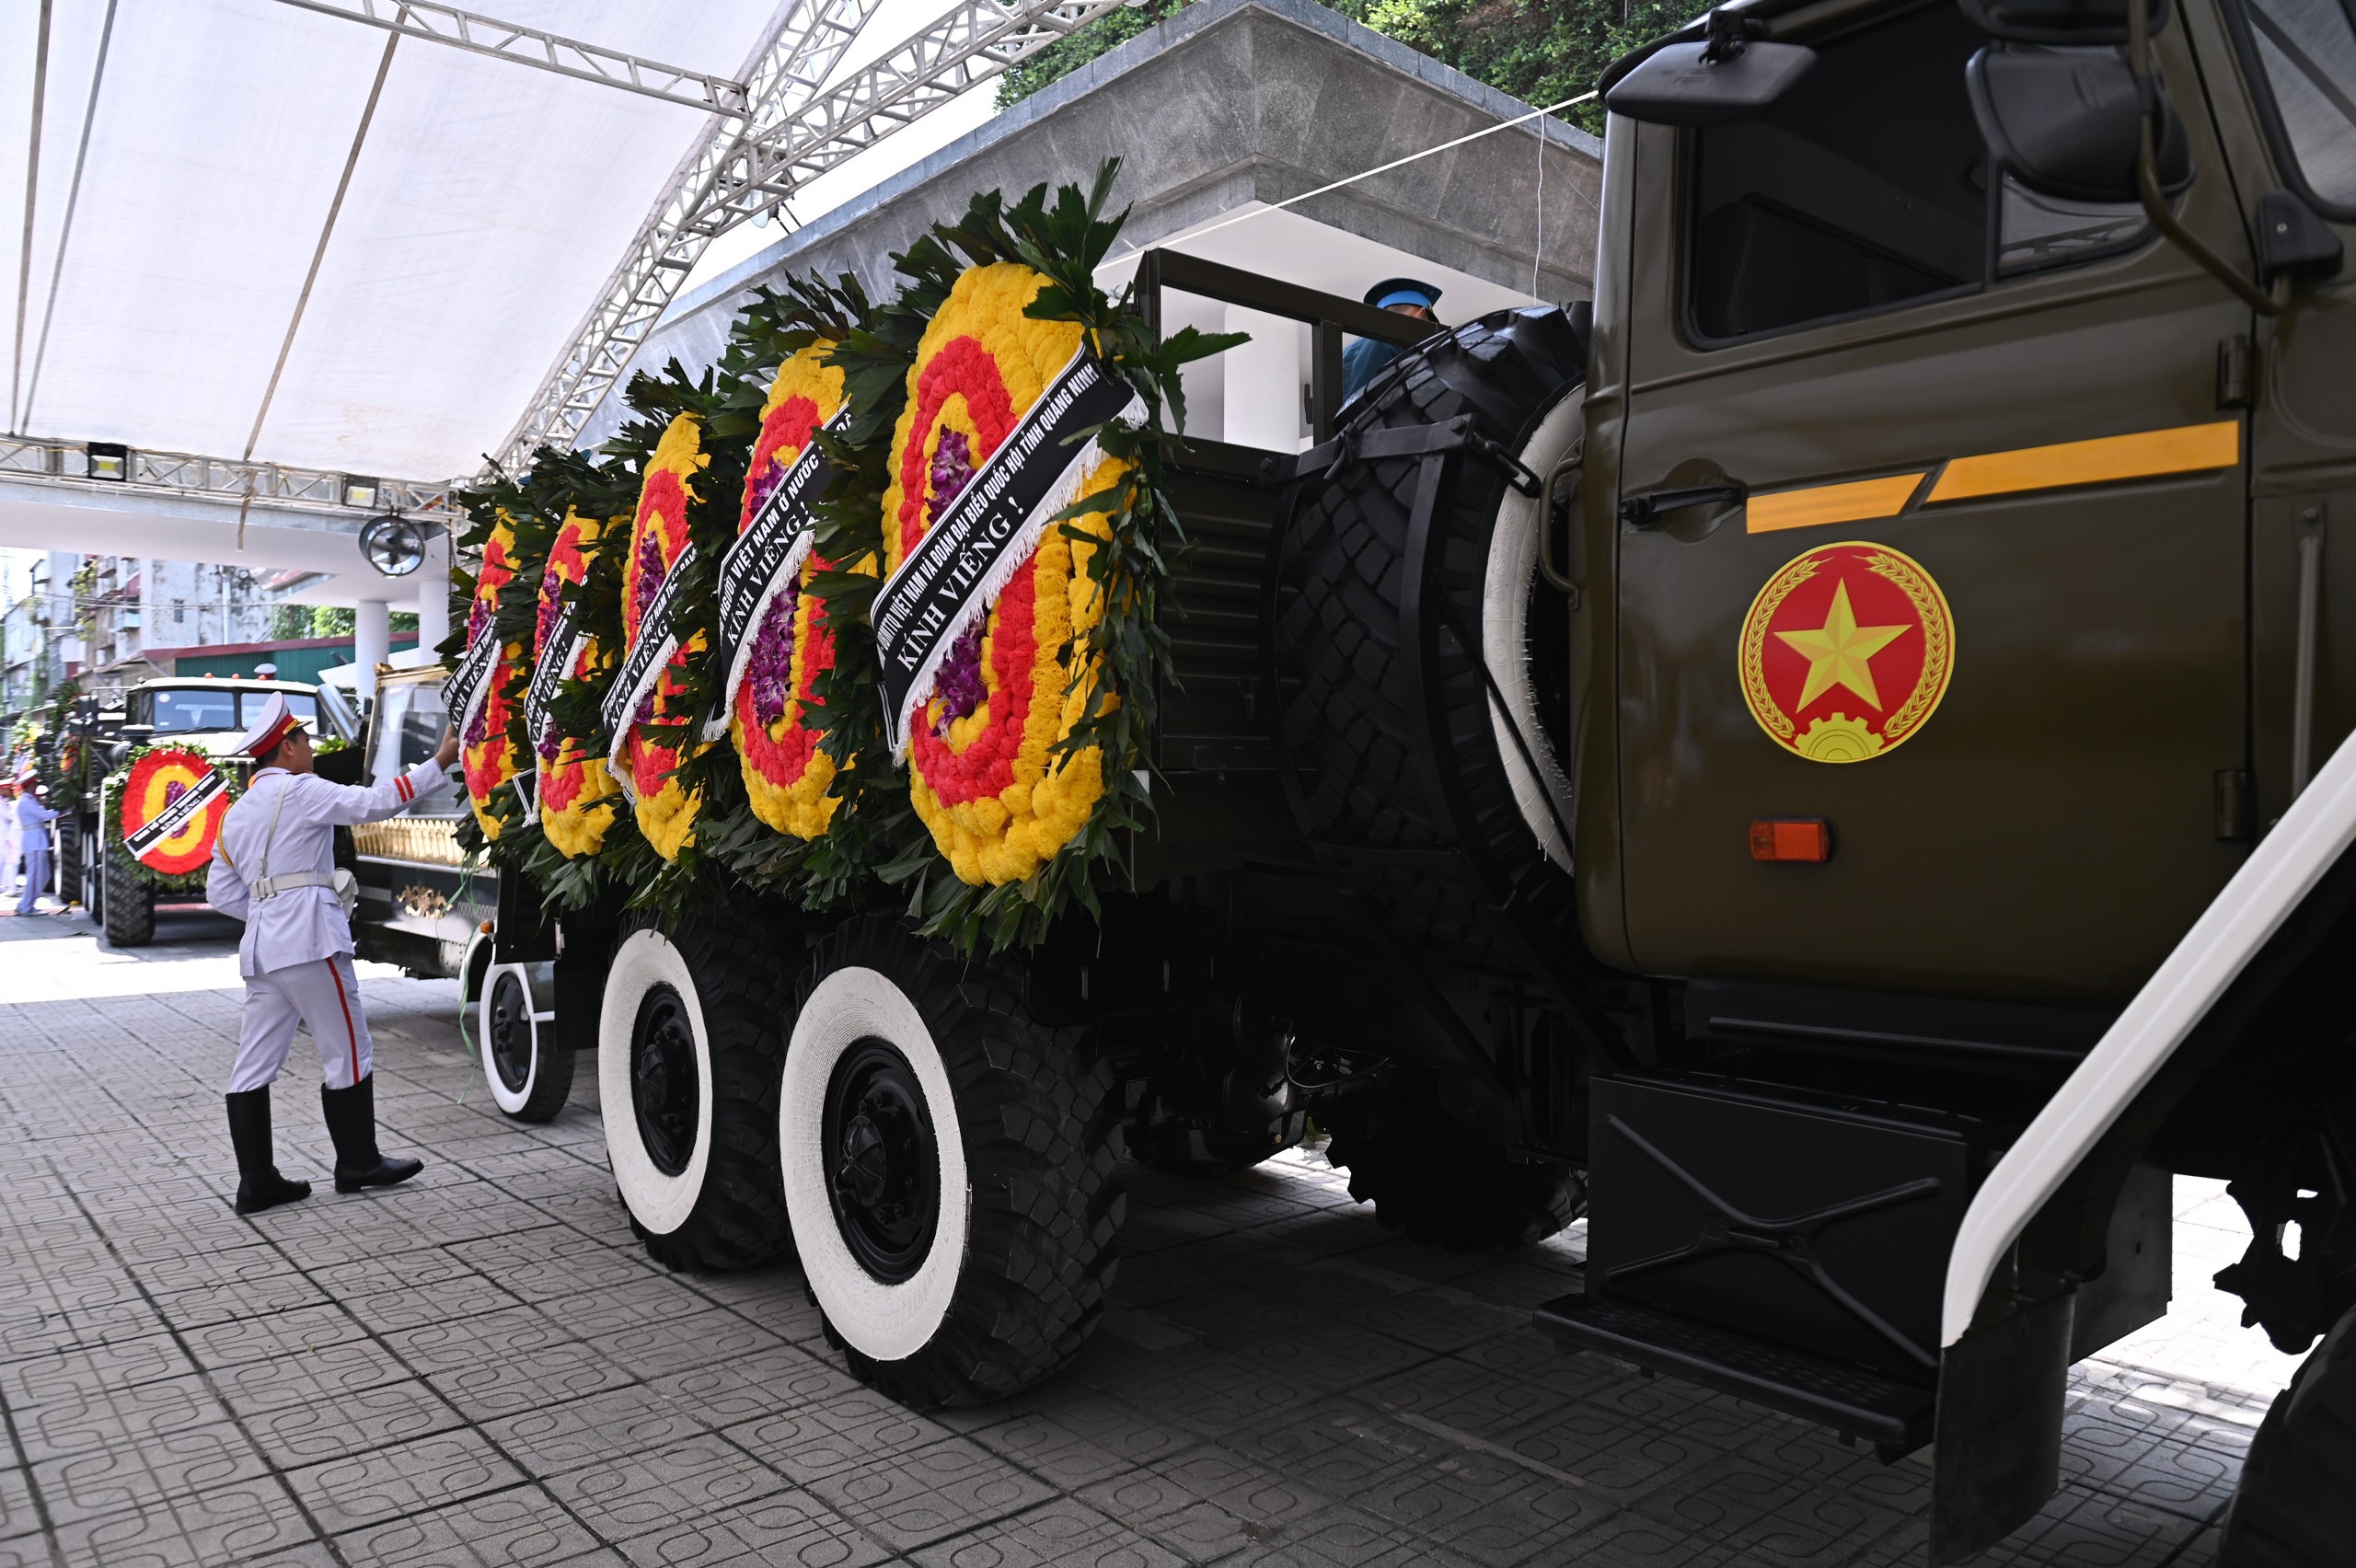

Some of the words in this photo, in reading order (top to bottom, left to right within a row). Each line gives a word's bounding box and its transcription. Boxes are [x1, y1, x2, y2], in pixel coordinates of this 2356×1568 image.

[720, 574, 736, 621] NGƯỜI
[731, 542, 755, 579] VIỆT
[752, 508, 780, 549] NAM
[777, 491, 790, 512] Ở
[788, 454, 819, 500] NƯỚC
[889, 592, 913, 621] VIỆT
[902, 571, 928, 603] NAM
[919, 557, 938, 581] VÀ
[930, 531, 958, 568] ĐOÀN
[950, 514, 971, 542] ĐẠI
[964, 490, 988, 524] BIỂU
[983, 465, 1011, 500] QUỐC
[1005, 446, 1025, 474] HỘI
[1020, 422, 1045, 455] TỈNH
[1039, 388, 1074, 431] QUẢNG
[1068, 363, 1100, 398] NINH
[642, 614, 654, 639] VIỆT
[653, 592, 667, 621] NAM
[727, 587, 755, 648] KÍNH
[749, 513, 802, 586] VIẾNG
[897, 601, 947, 672] KÍNH
[938, 512, 1011, 601] VIẾNG
[451, 692, 467, 731] KÍNH
[463, 647, 492, 693] VIẾNG
[540, 652, 565, 703] VIẾNG
[541, 648, 554, 679] QUAN
[610, 677, 631, 730] KÍNH
[631, 619, 668, 678] VIẾNG
